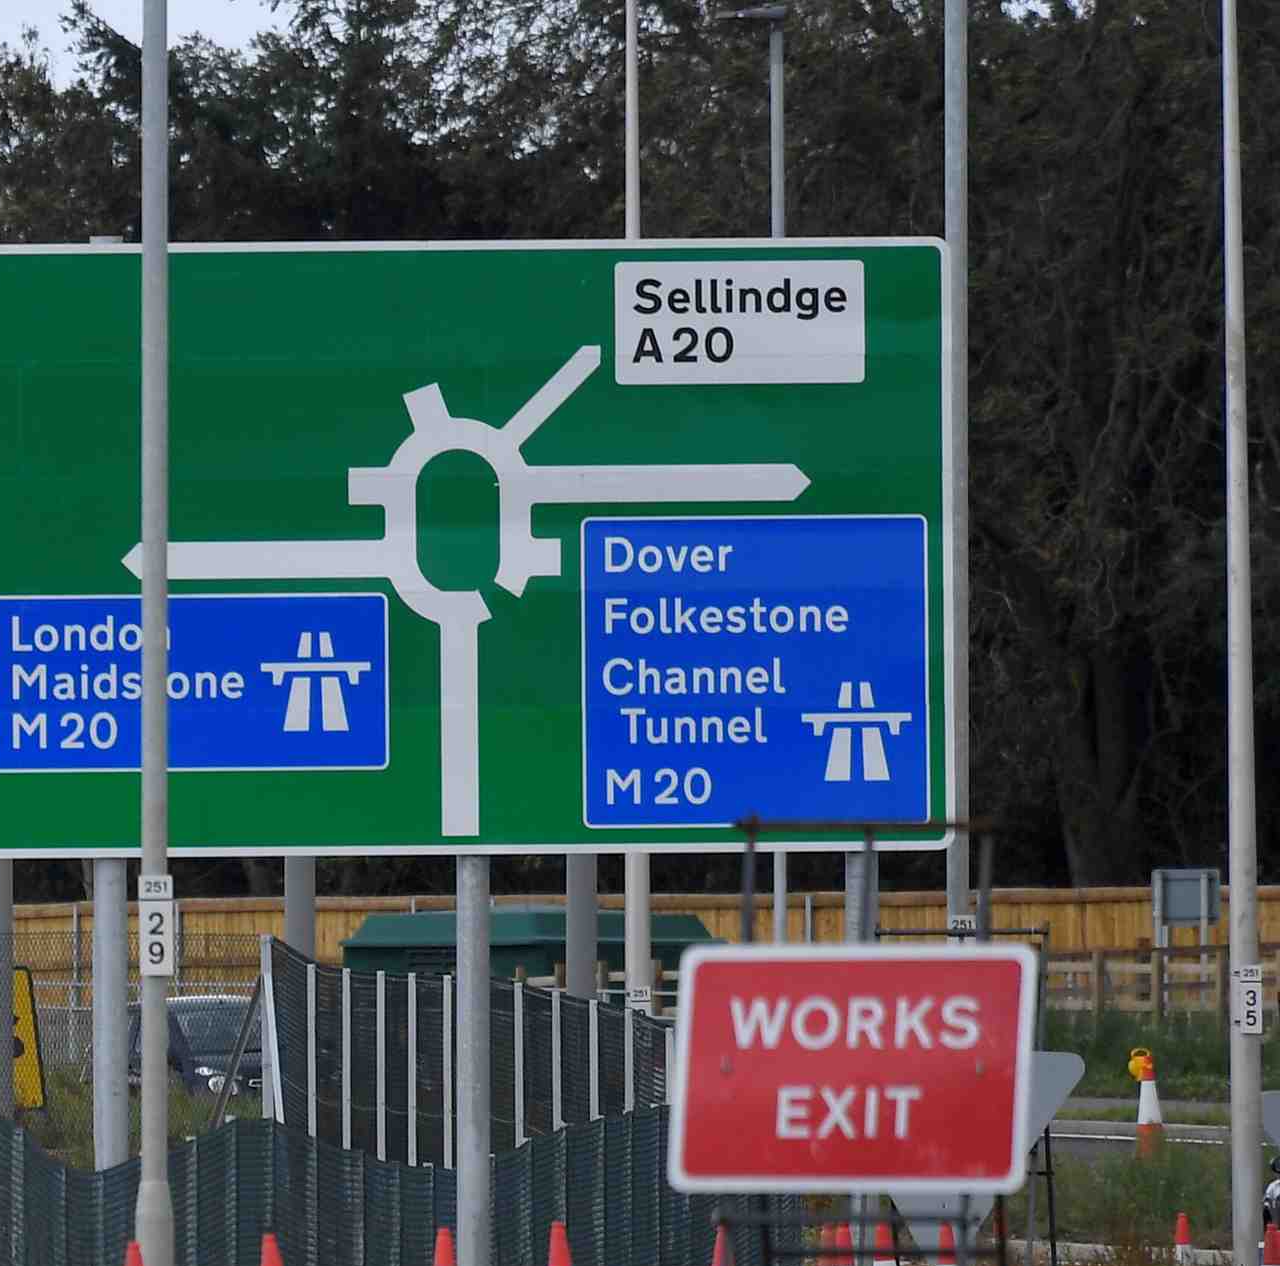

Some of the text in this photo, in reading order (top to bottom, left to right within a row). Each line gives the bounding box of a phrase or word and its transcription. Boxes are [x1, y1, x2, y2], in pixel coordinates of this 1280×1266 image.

[633, 278, 848, 320] Sellindge
[632, 326, 734, 364] A20
[604, 536, 733, 573] Dover
[11, 615, 171, 652] Londo
[604, 597, 849, 634] Folkestone
[11, 663, 245, 701] Maidsone
[602, 656, 786, 695] Channel
[620, 706, 767, 744] Tunnel
[144, 880, 168, 894] 251
[729, 996, 981, 1050] WORKS
[775, 1084, 923, 1139] EXIT
